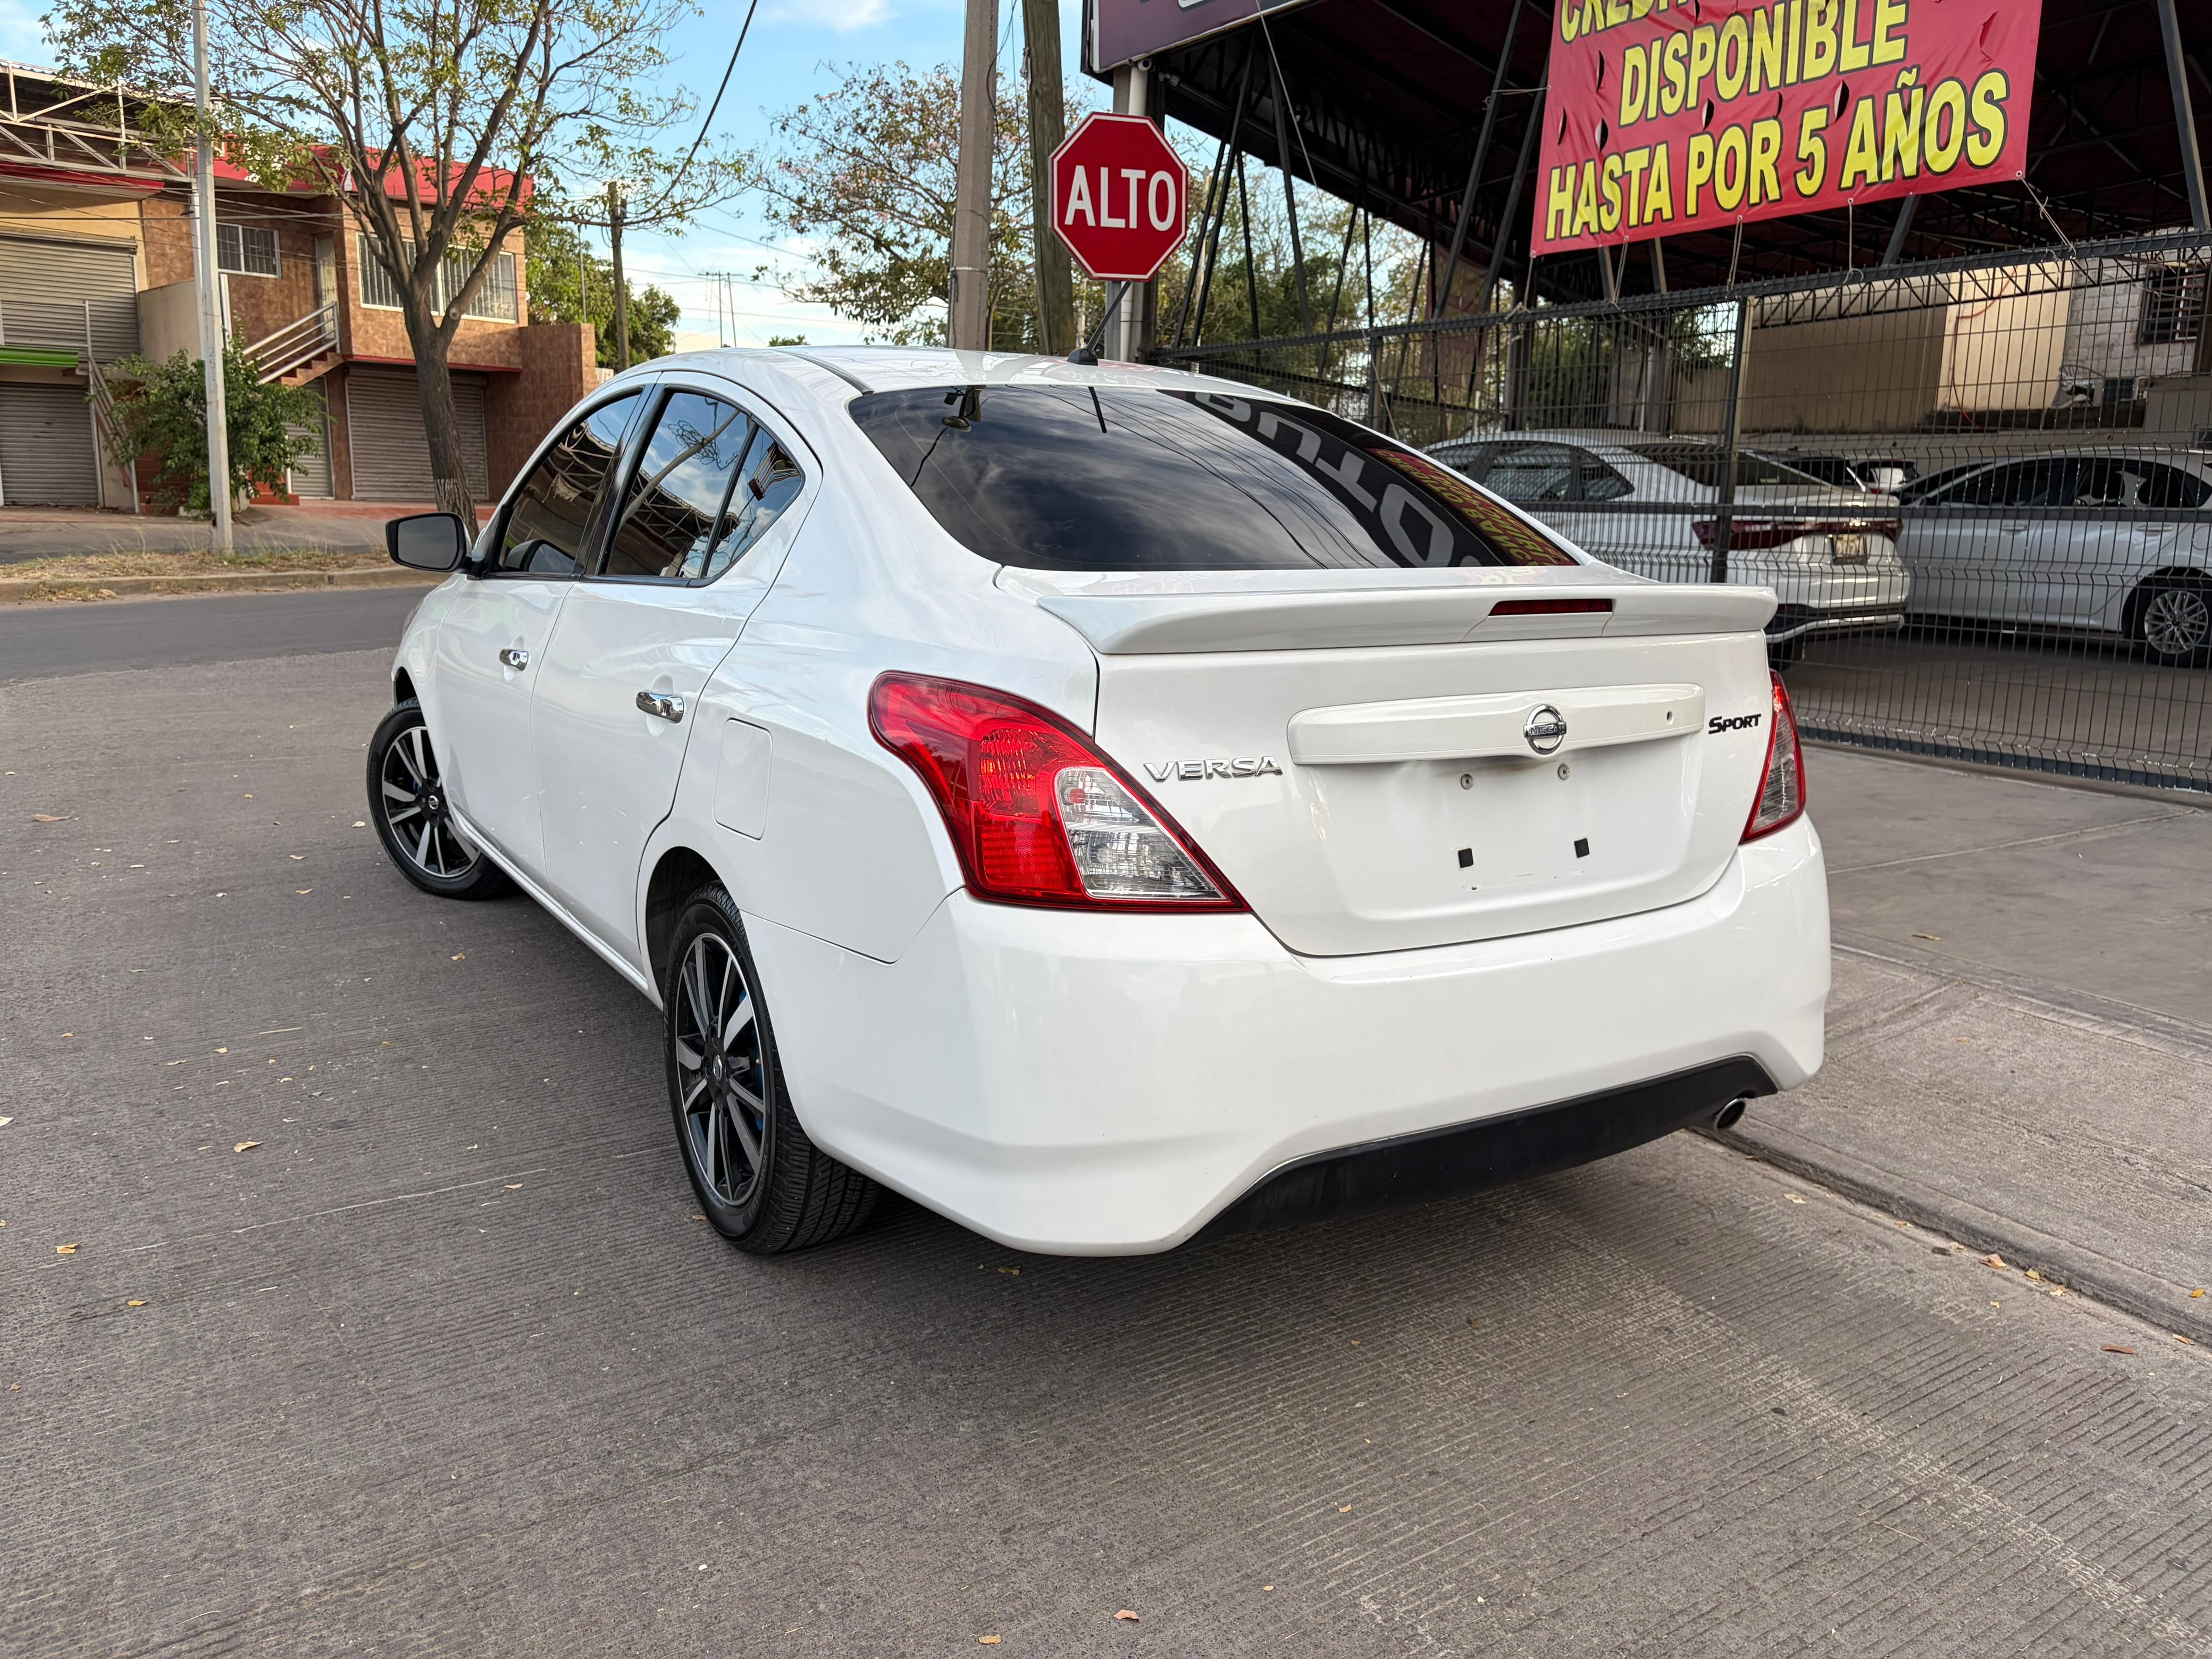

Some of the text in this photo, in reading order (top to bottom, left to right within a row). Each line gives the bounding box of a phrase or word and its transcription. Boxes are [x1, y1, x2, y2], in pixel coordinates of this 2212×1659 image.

[1619, 0, 1908, 127] DISPONIBLE
[1545, 68, 2008, 241] HASTA POR 5 AÑOS
[1065, 165, 1176, 231] ALTO
[1529, 724, 1564, 735] NISSAN
[1143, 756, 1284, 782] VERSA
